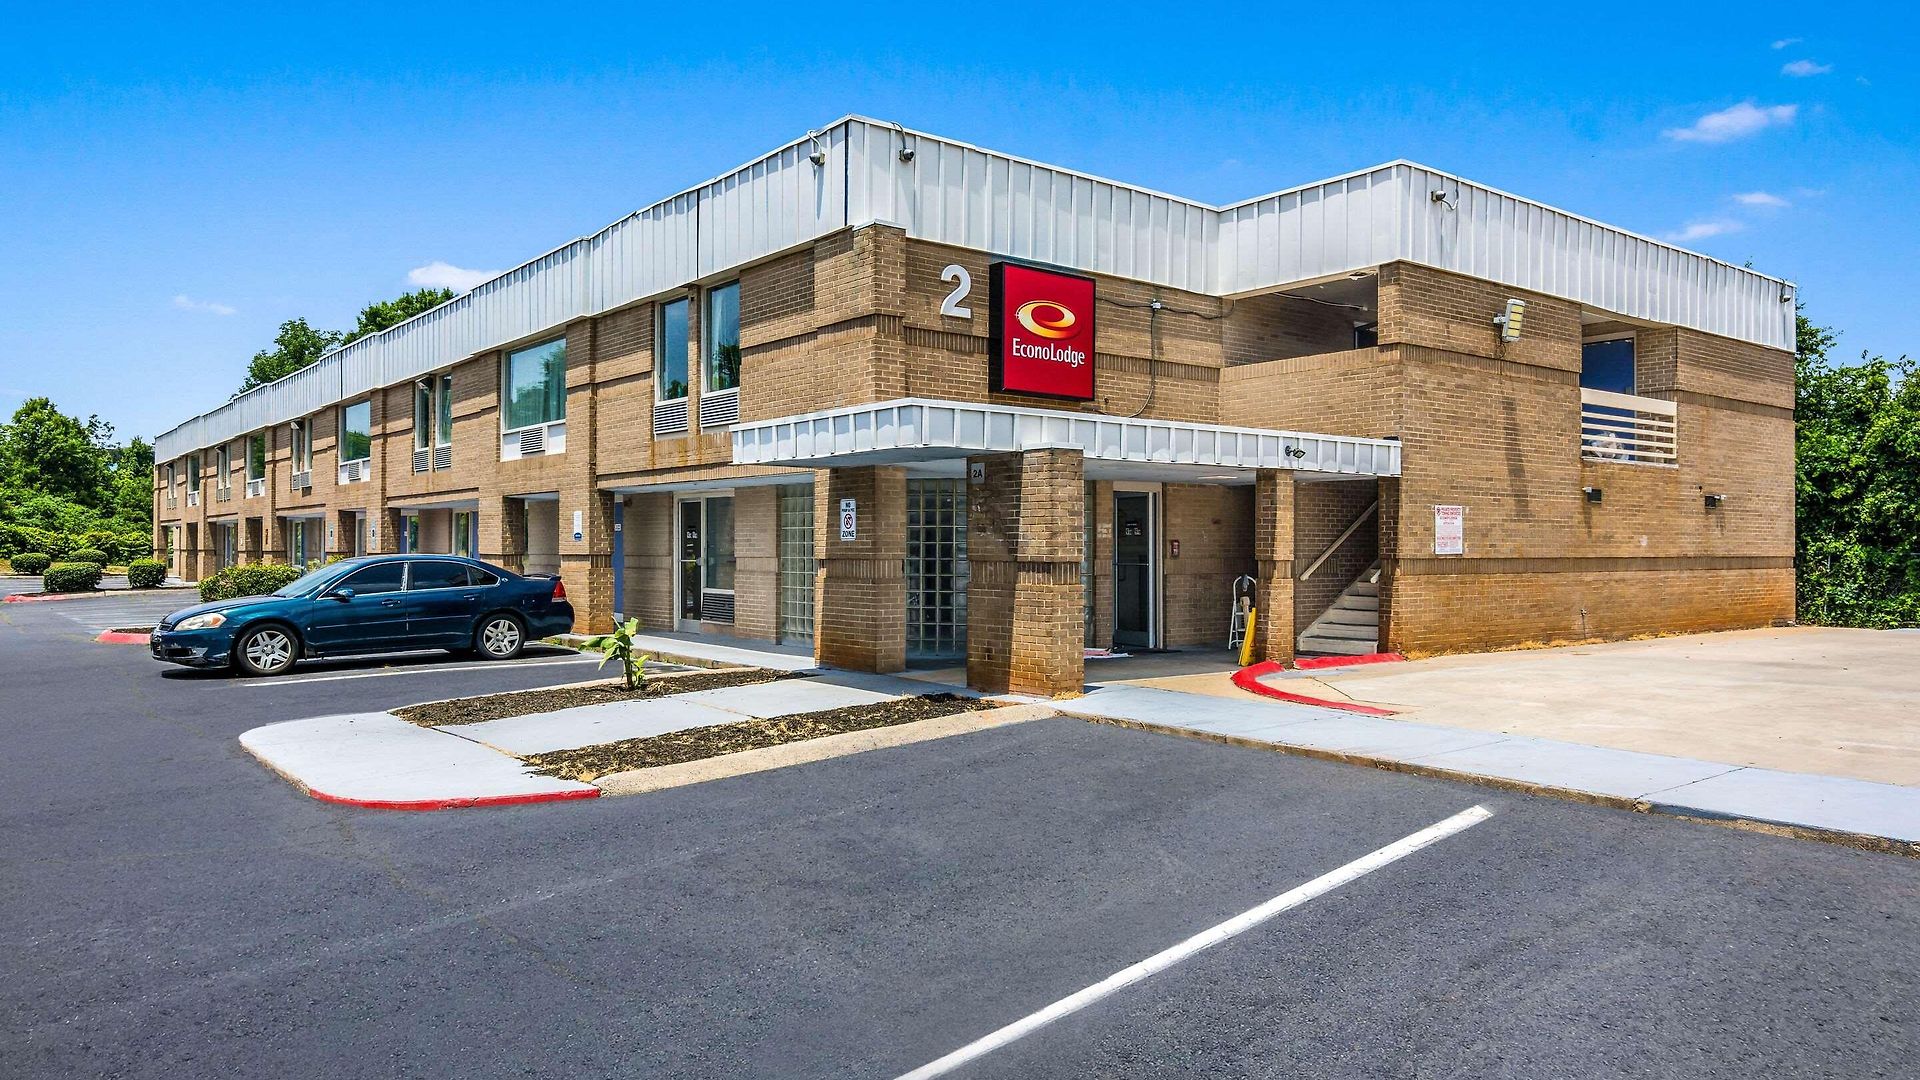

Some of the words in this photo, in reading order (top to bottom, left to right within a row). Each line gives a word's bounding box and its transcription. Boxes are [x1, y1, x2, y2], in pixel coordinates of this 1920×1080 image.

[940, 264, 972, 319] 2
[1012, 337, 1085, 368] EconoLodge
[973, 469, 983, 478] 2A
[842, 530, 855, 538] ZONE
